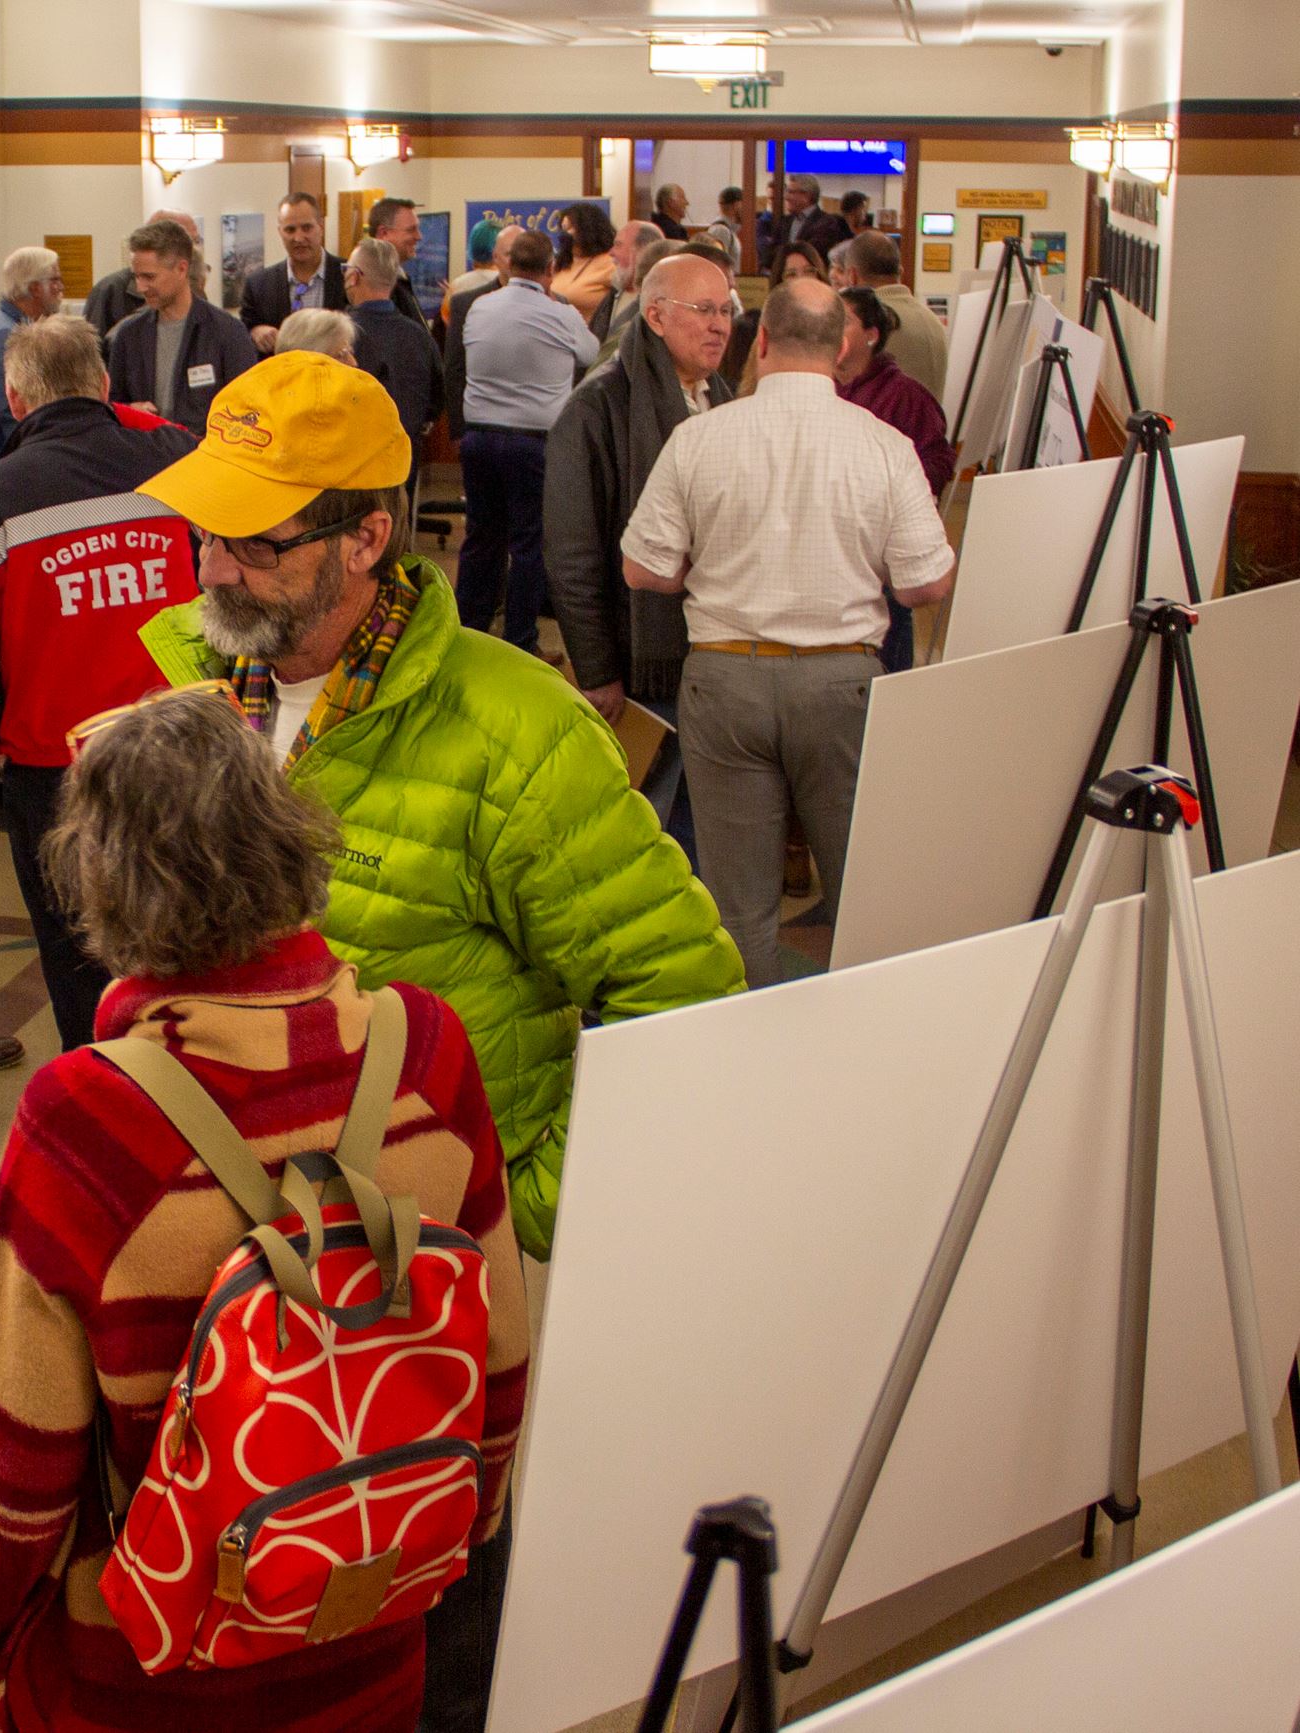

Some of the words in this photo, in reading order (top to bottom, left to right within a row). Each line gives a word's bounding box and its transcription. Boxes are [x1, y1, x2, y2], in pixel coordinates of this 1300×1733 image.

[731, 80, 770, 108] EXIT
[527, 207, 547, 231] of
[982, 220, 1017, 228] NOTICE
[41, 532, 116, 573] OGDEN
[125, 530, 173, 553] CITY
[55, 557, 167, 616] FIRE
